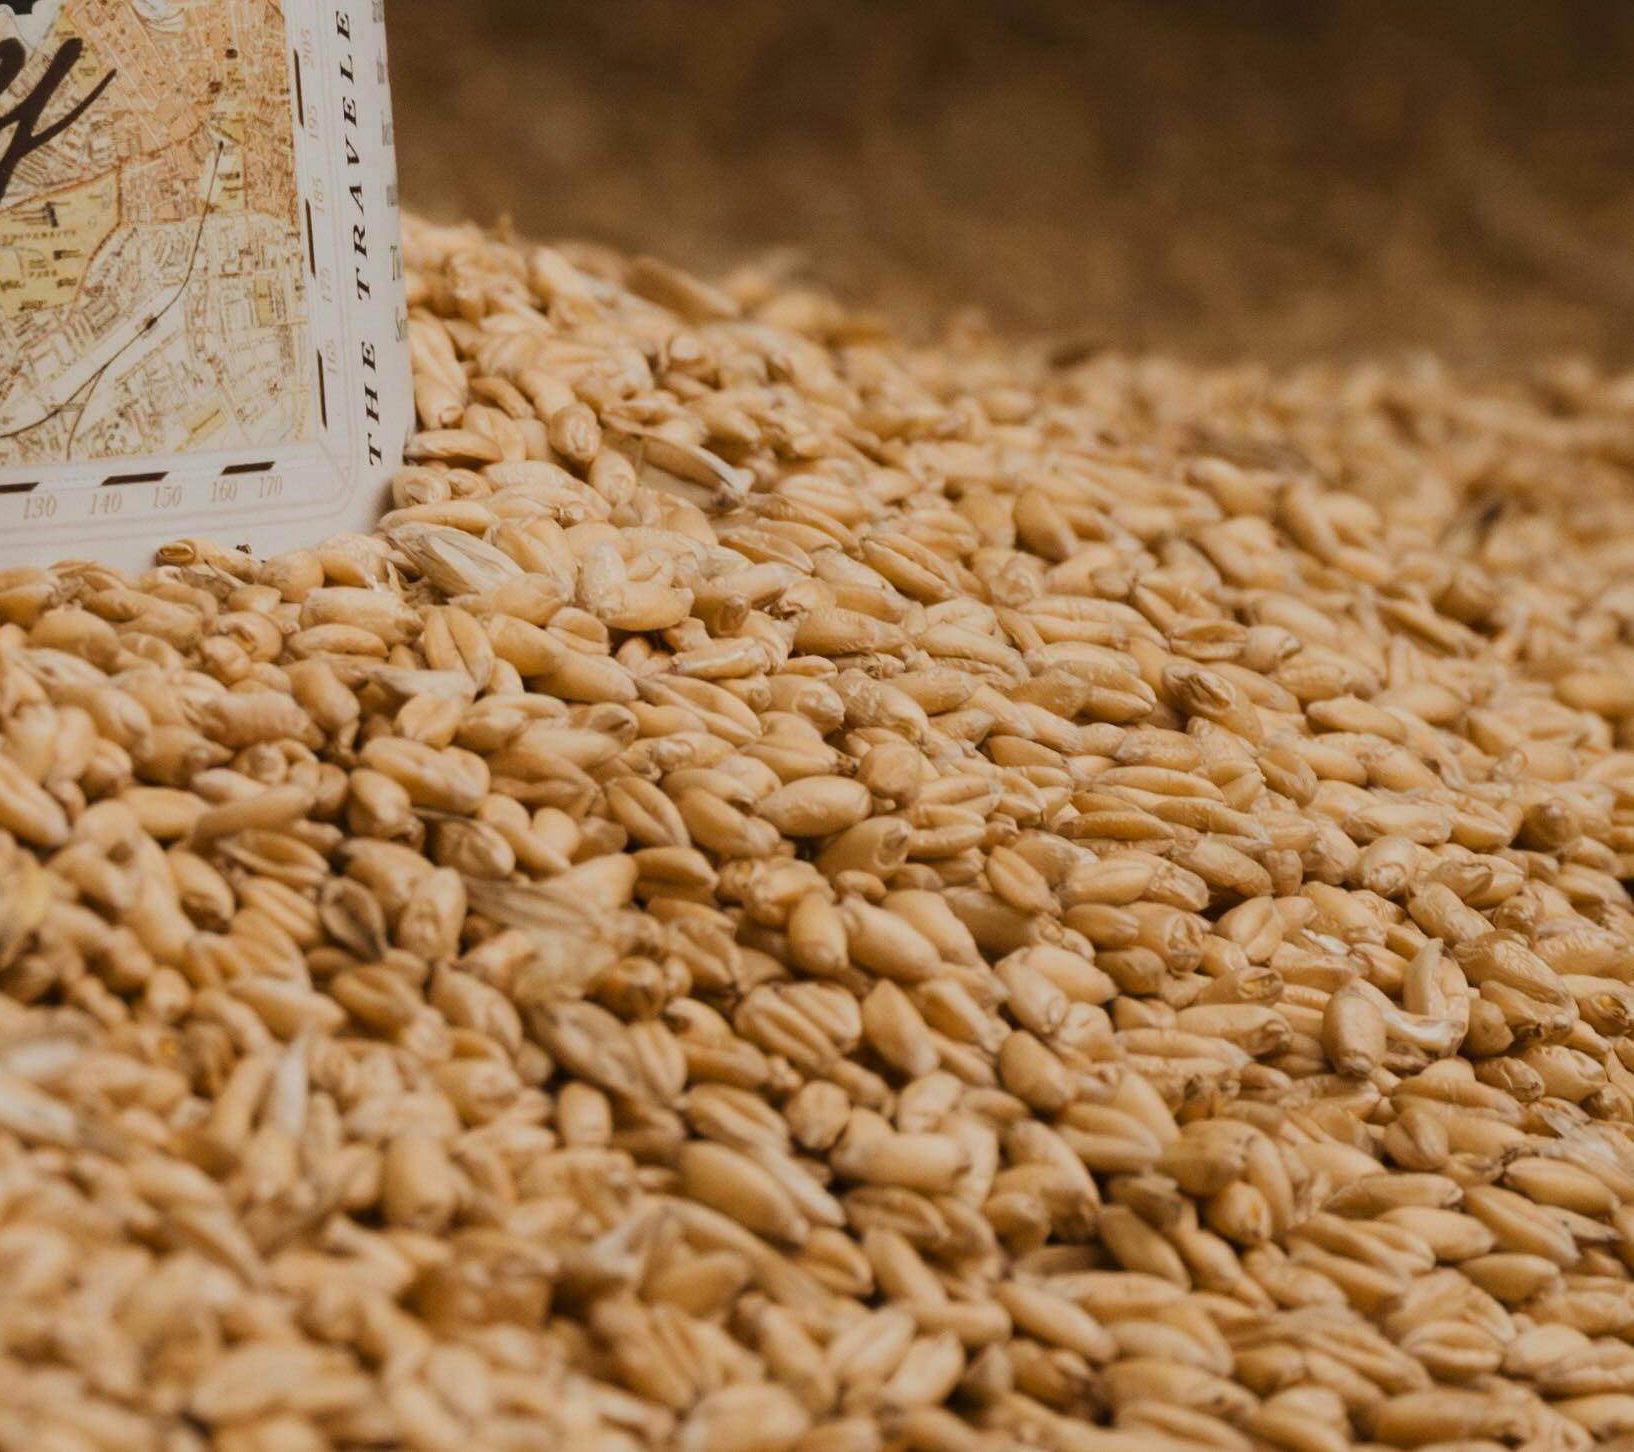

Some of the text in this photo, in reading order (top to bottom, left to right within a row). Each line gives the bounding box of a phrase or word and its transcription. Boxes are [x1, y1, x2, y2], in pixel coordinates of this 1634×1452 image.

[361, 340, 383, 467] THE
[22, 494, 58, 520] 130
[88, 491, 123, 515] 140
[151, 485, 183, 509] 150
[210, 479, 239, 503] 160
[258, 475, 283, 499] 170
